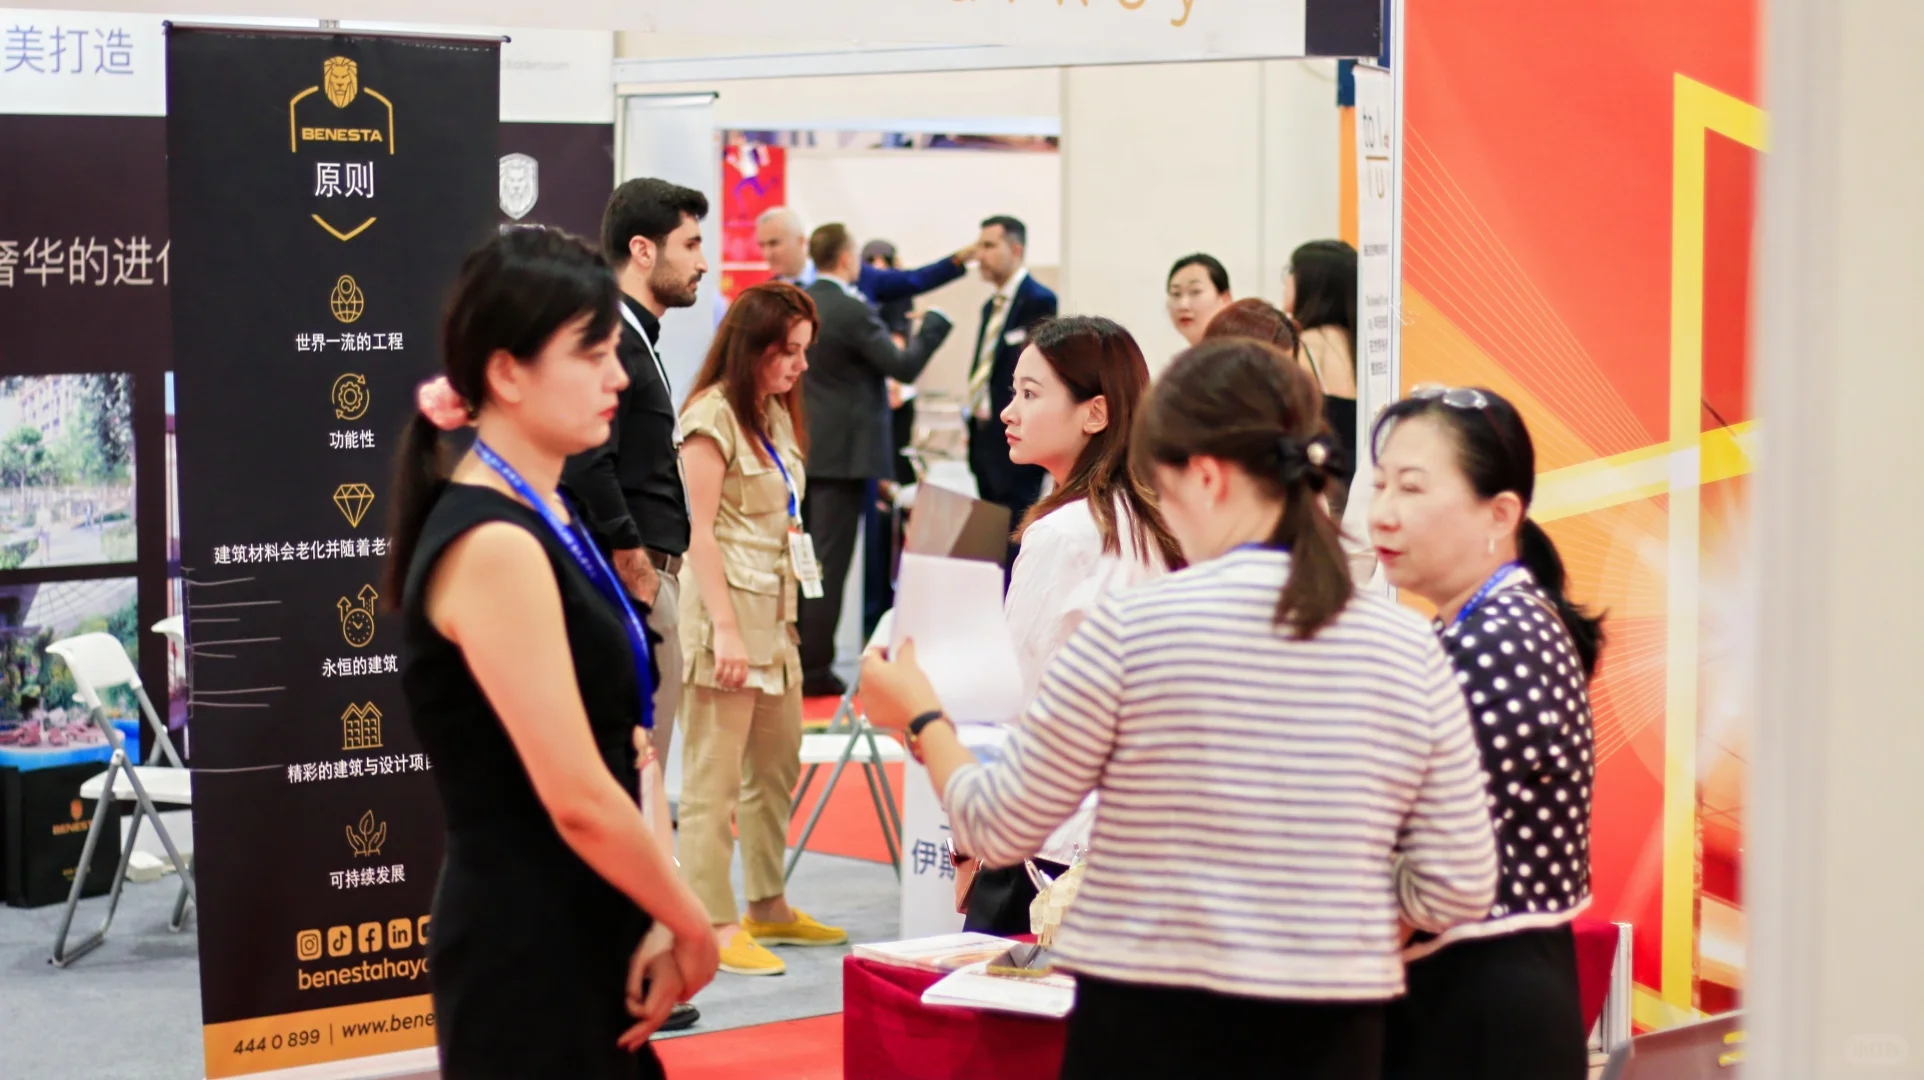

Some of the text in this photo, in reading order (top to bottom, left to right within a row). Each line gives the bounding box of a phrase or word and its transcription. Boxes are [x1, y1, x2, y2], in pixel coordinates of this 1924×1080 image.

[4, 24, 134, 75] 美打造
[301, 127, 383, 142] BENESTA
[314, 161, 375, 199] 原则
[295, 332, 404, 352] 世界一流的工程
[329, 429, 375, 449] 功能性
[322, 654, 399, 678] 永恒的建筑
[329, 864, 405, 889] 可持续发展
[233, 1037, 266, 1054] 444
[288, 1029, 320, 1047] 899
